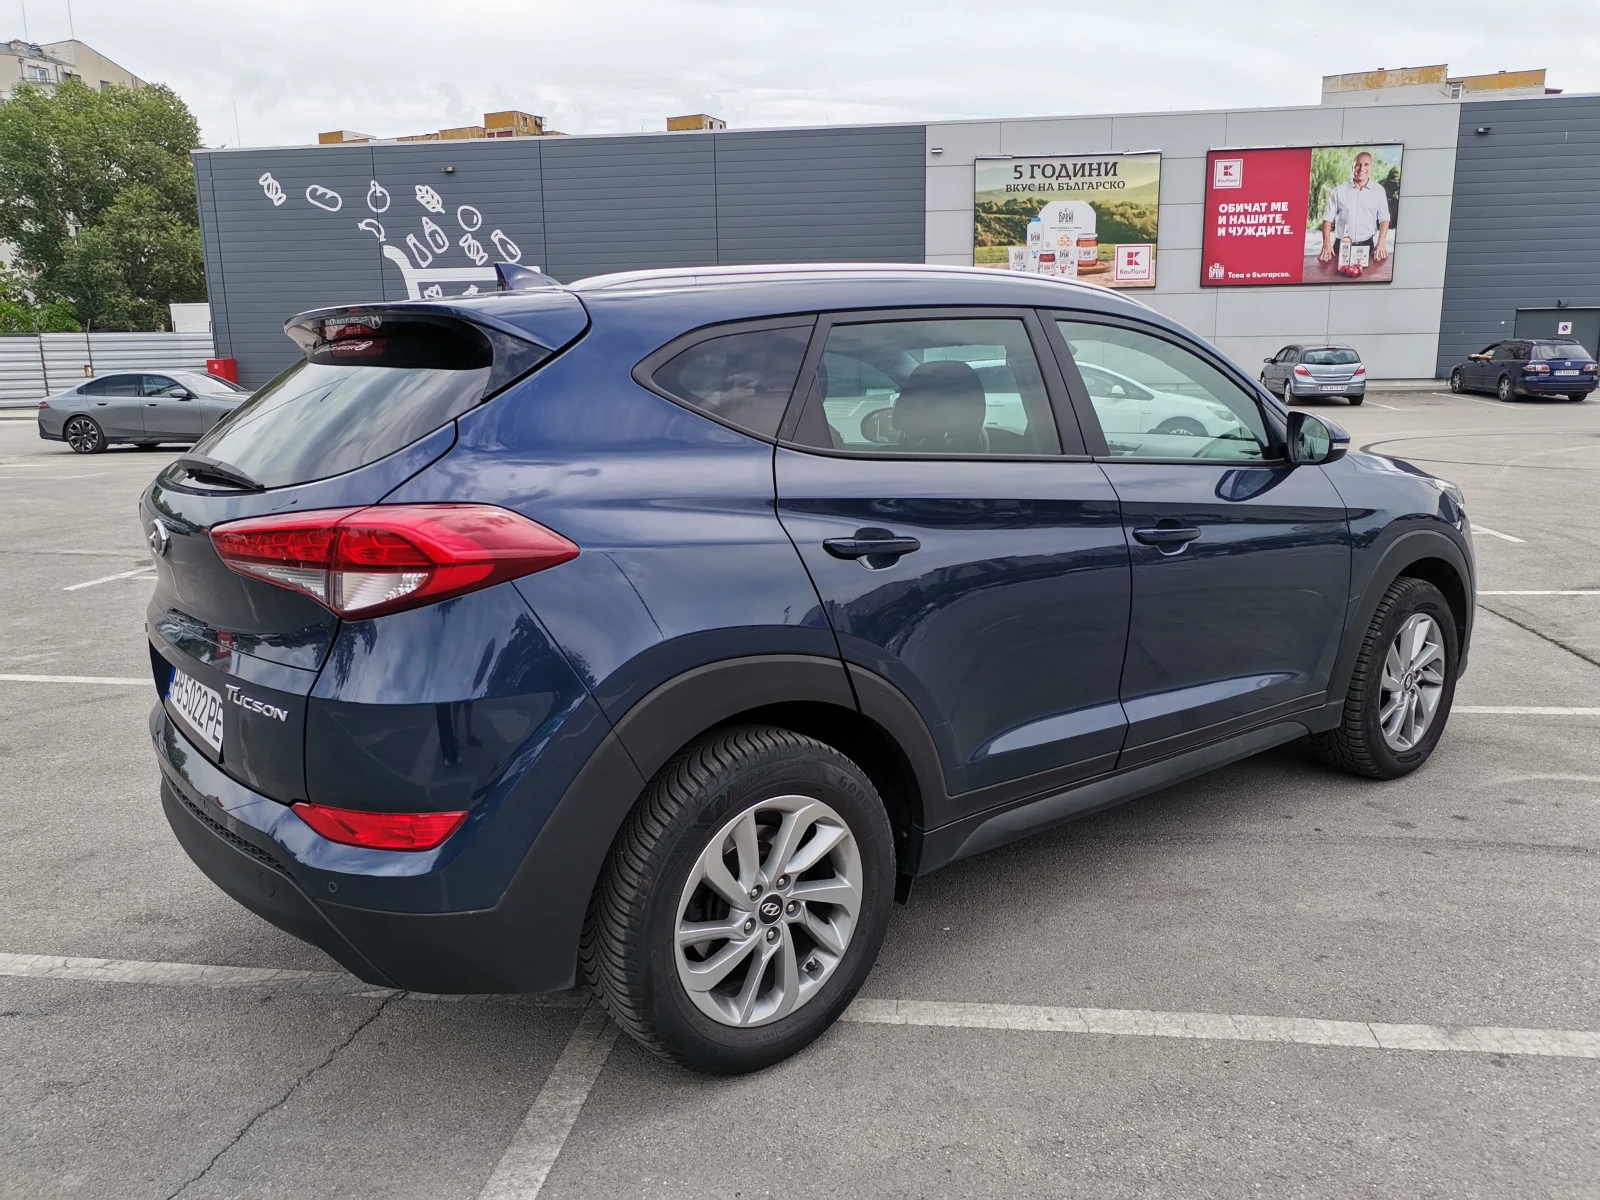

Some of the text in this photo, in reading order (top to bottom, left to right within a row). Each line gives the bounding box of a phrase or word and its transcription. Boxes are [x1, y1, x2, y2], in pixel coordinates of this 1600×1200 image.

[1013, 162, 1119, 180] 5 ГОДИНИ
[1005, 180, 1126, 193] ВКУС НА БЪЛГАРСКО
[1218, 201, 1289, 214] ОБИЧАТ МЕ
[1217, 213, 1286, 225] И НАШИТЕ,
[1217, 225, 1294, 238] И ЧУЖДИТЕ.
[1251, 271, 1291, 279] българско.
